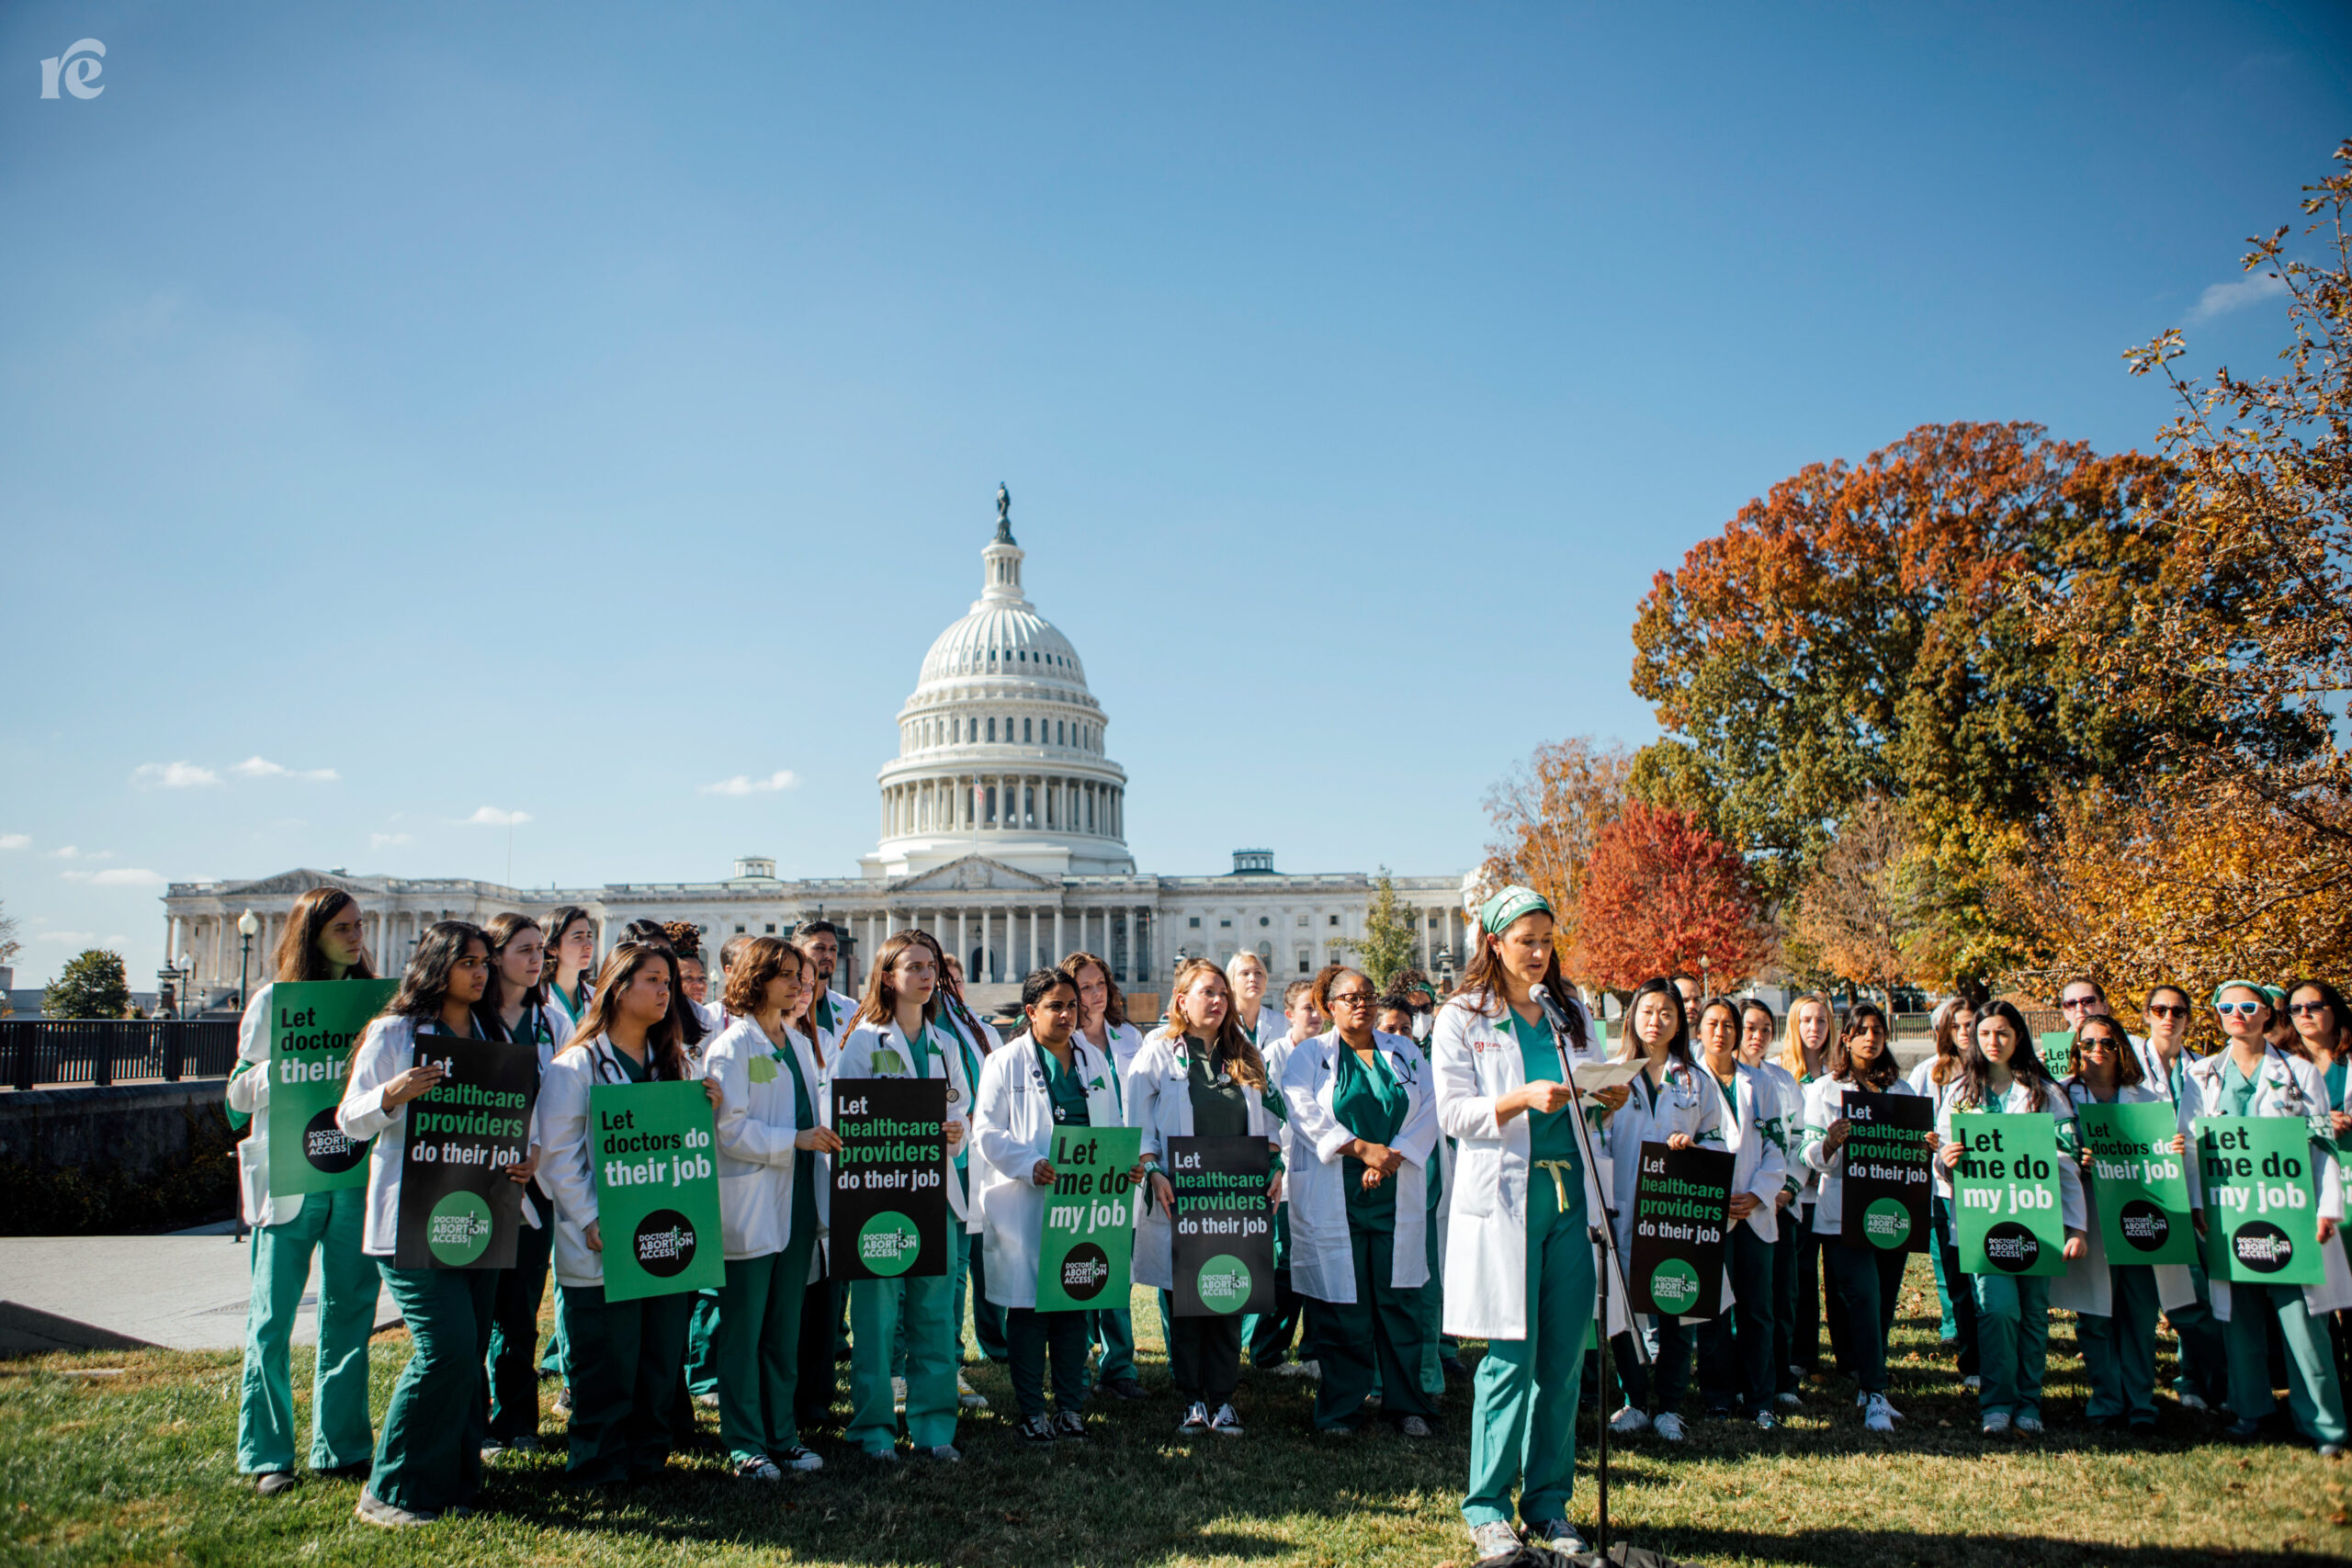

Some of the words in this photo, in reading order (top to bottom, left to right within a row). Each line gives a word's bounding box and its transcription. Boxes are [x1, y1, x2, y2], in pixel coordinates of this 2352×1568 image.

[281, 1008, 316, 1028] Let
[280, 1055, 345, 1084] their
[838, 1096, 867, 1115] Let
[1847, 1104, 1872, 1121] Let
[415, 1110, 524, 1137] providers
[601, 1110, 634, 1131] Let
[839, 1119, 940, 1137] healthcare
[2086, 1122, 2109, 1137] Let
[309, 1129, 345, 1139] DOCTOR
[603, 1132, 682, 1154] doctors
[685, 1128, 709, 1148] do
[1960, 1128, 2004, 1152] Let
[2203, 1126, 2249, 1150] Let
[309, 1145, 347, 1156] ACCESS
[412, 1141, 437, 1163] do
[443, 1143, 489, 1165] their
[838, 1141, 941, 1168] providers
[1057, 1136, 1098, 1165] Let
[1849, 1143, 1928, 1163] providers
[2091, 1140, 2150, 1156] doctors
[1174, 1152, 1201, 1168] Let
[1643, 1156, 1665, 1174] Let
[1962, 1157, 2005, 1179] me
[2014, 1154, 2050, 1179] do
[2207, 1157, 2253, 1177] me
[2262, 1152, 2301, 1178] do
[605, 1157, 667, 1187] their
[673, 1154, 711, 1187] job
[838, 1170, 860, 1190] do
[865, 1169, 908, 1189] their
[911, 1168, 940, 1192] job
[1849, 1163, 1867, 1178] do
[1870, 1165, 1904, 1181] their
[1905, 1167, 1928, 1185] job
[2096, 1160, 2139, 1179] their
[2143, 1159, 2179, 1185] job
[1054, 1170, 1093, 1195] me
[1099, 1166, 1129, 1194] do
[1175, 1172, 1264, 1189] healthcare
[1641, 1176, 1724, 1200] healthcare
[1178, 1191, 1266, 1214] providers
[1962, 1188, 2002, 1214] my
[2008, 1183, 2052, 1214] job
[2209, 1184, 2249, 1213] my
[2256, 1181, 2306, 1214] job
[1049, 1205, 1085, 1235] my
[1088, 1199, 1126, 1235] job
[1639, 1198, 1722, 1222] providers
[432, 1224, 489, 1235] ABORTION
[1178, 1218, 1198, 1235] do
[1202, 1216, 1240, 1235] their
[1242, 1216, 1267, 1237] job
[1638, 1220, 1656, 1236] do
[1658, 1222, 1694, 1240] their
[1694, 1225, 1720, 1245] job
[1867, 1220, 1909, 1229] ABORTION
[432, 1235, 468, 1244] ACCESS
[639, 1233, 674, 1242] DOCTORS
[639, 1236, 694, 1252] ABORTION
[864, 1240, 917, 1249] ABORTION
[639, 1248, 675, 1260] ACCESS
[864, 1249, 899, 1258] ACCESS
[1989, 1244, 2037, 1252] ABORTION
[2238, 1243, 2291, 1253] ABORTION
[1065, 1268, 1107, 1277] ABORTION
[1655, 1275, 1681, 1283] DOCTORS
[1202, 1280, 1248, 1290] ABORTION
[1202, 1288, 1232, 1297] ACCESS
[1654, 1290, 1681, 1298] ACCESS
[1655, 1282, 1697, 1293] ABORTION
